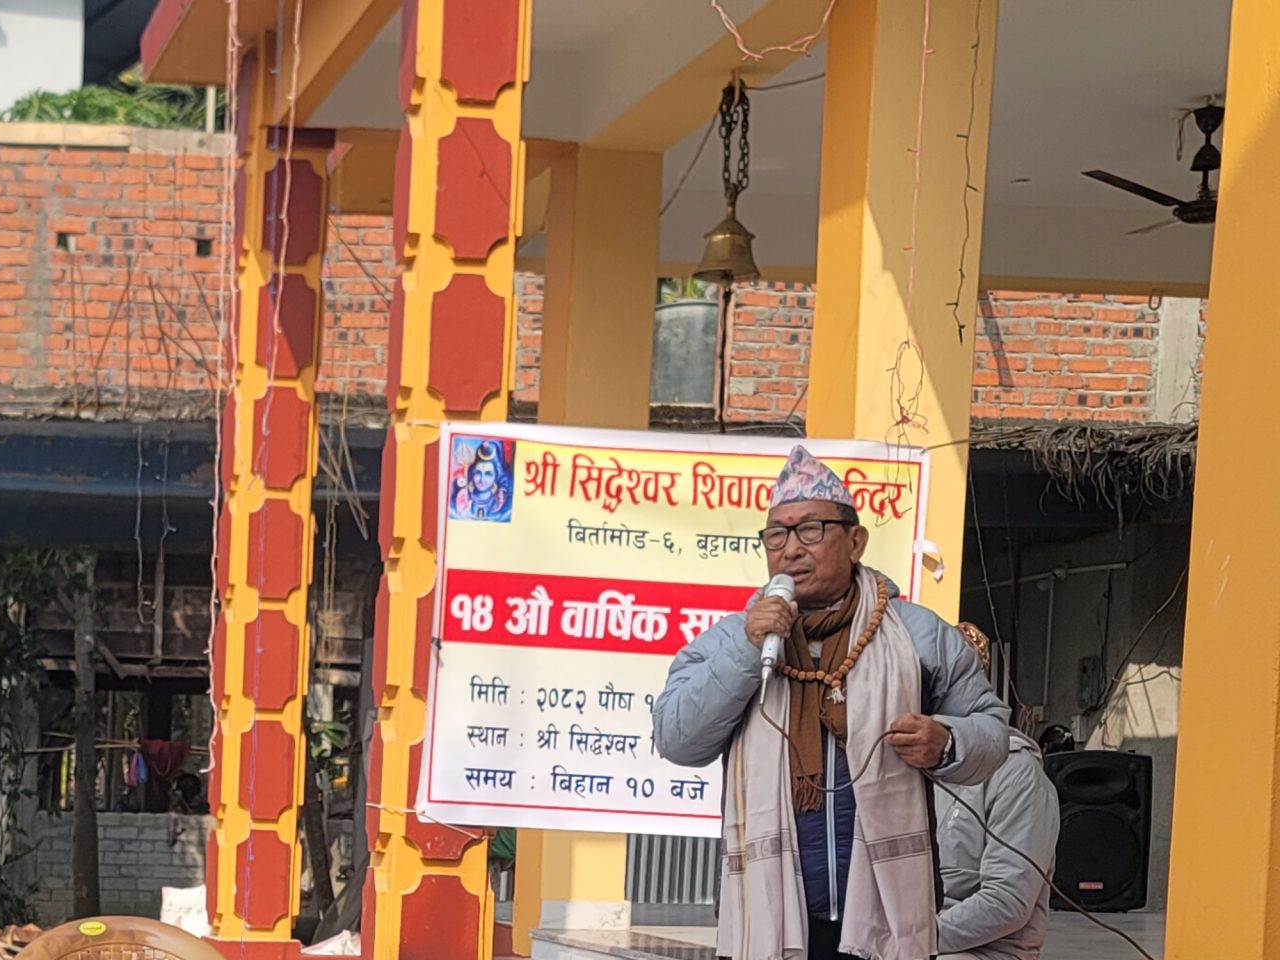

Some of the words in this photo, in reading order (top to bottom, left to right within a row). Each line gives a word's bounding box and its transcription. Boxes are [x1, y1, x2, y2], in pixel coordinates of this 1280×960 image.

[523, 451, 561, 497] श्री
[691, 461, 772, 512] शिवाल
[842, 467, 908, 519] न्दिर
[695, 533, 762, 560] बुट्टाबार
[450, 593, 494, 632] १४
[560, 589, 671, 642] वार्षिक
[469, 675, 510, 706] मिति
[536, 687, 587, 715] २०८२
[598, 681, 635, 712] पौष
[644, 693, 654, 714] १
[466, 725, 509, 748] स्थान
[536, 723, 560, 750] श्री
[464, 767, 516, 795] समय
[550, 764, 614, 799] बिहान
[625, 776, 655, 799] १०
[670, 774, 710, 801] बजे
